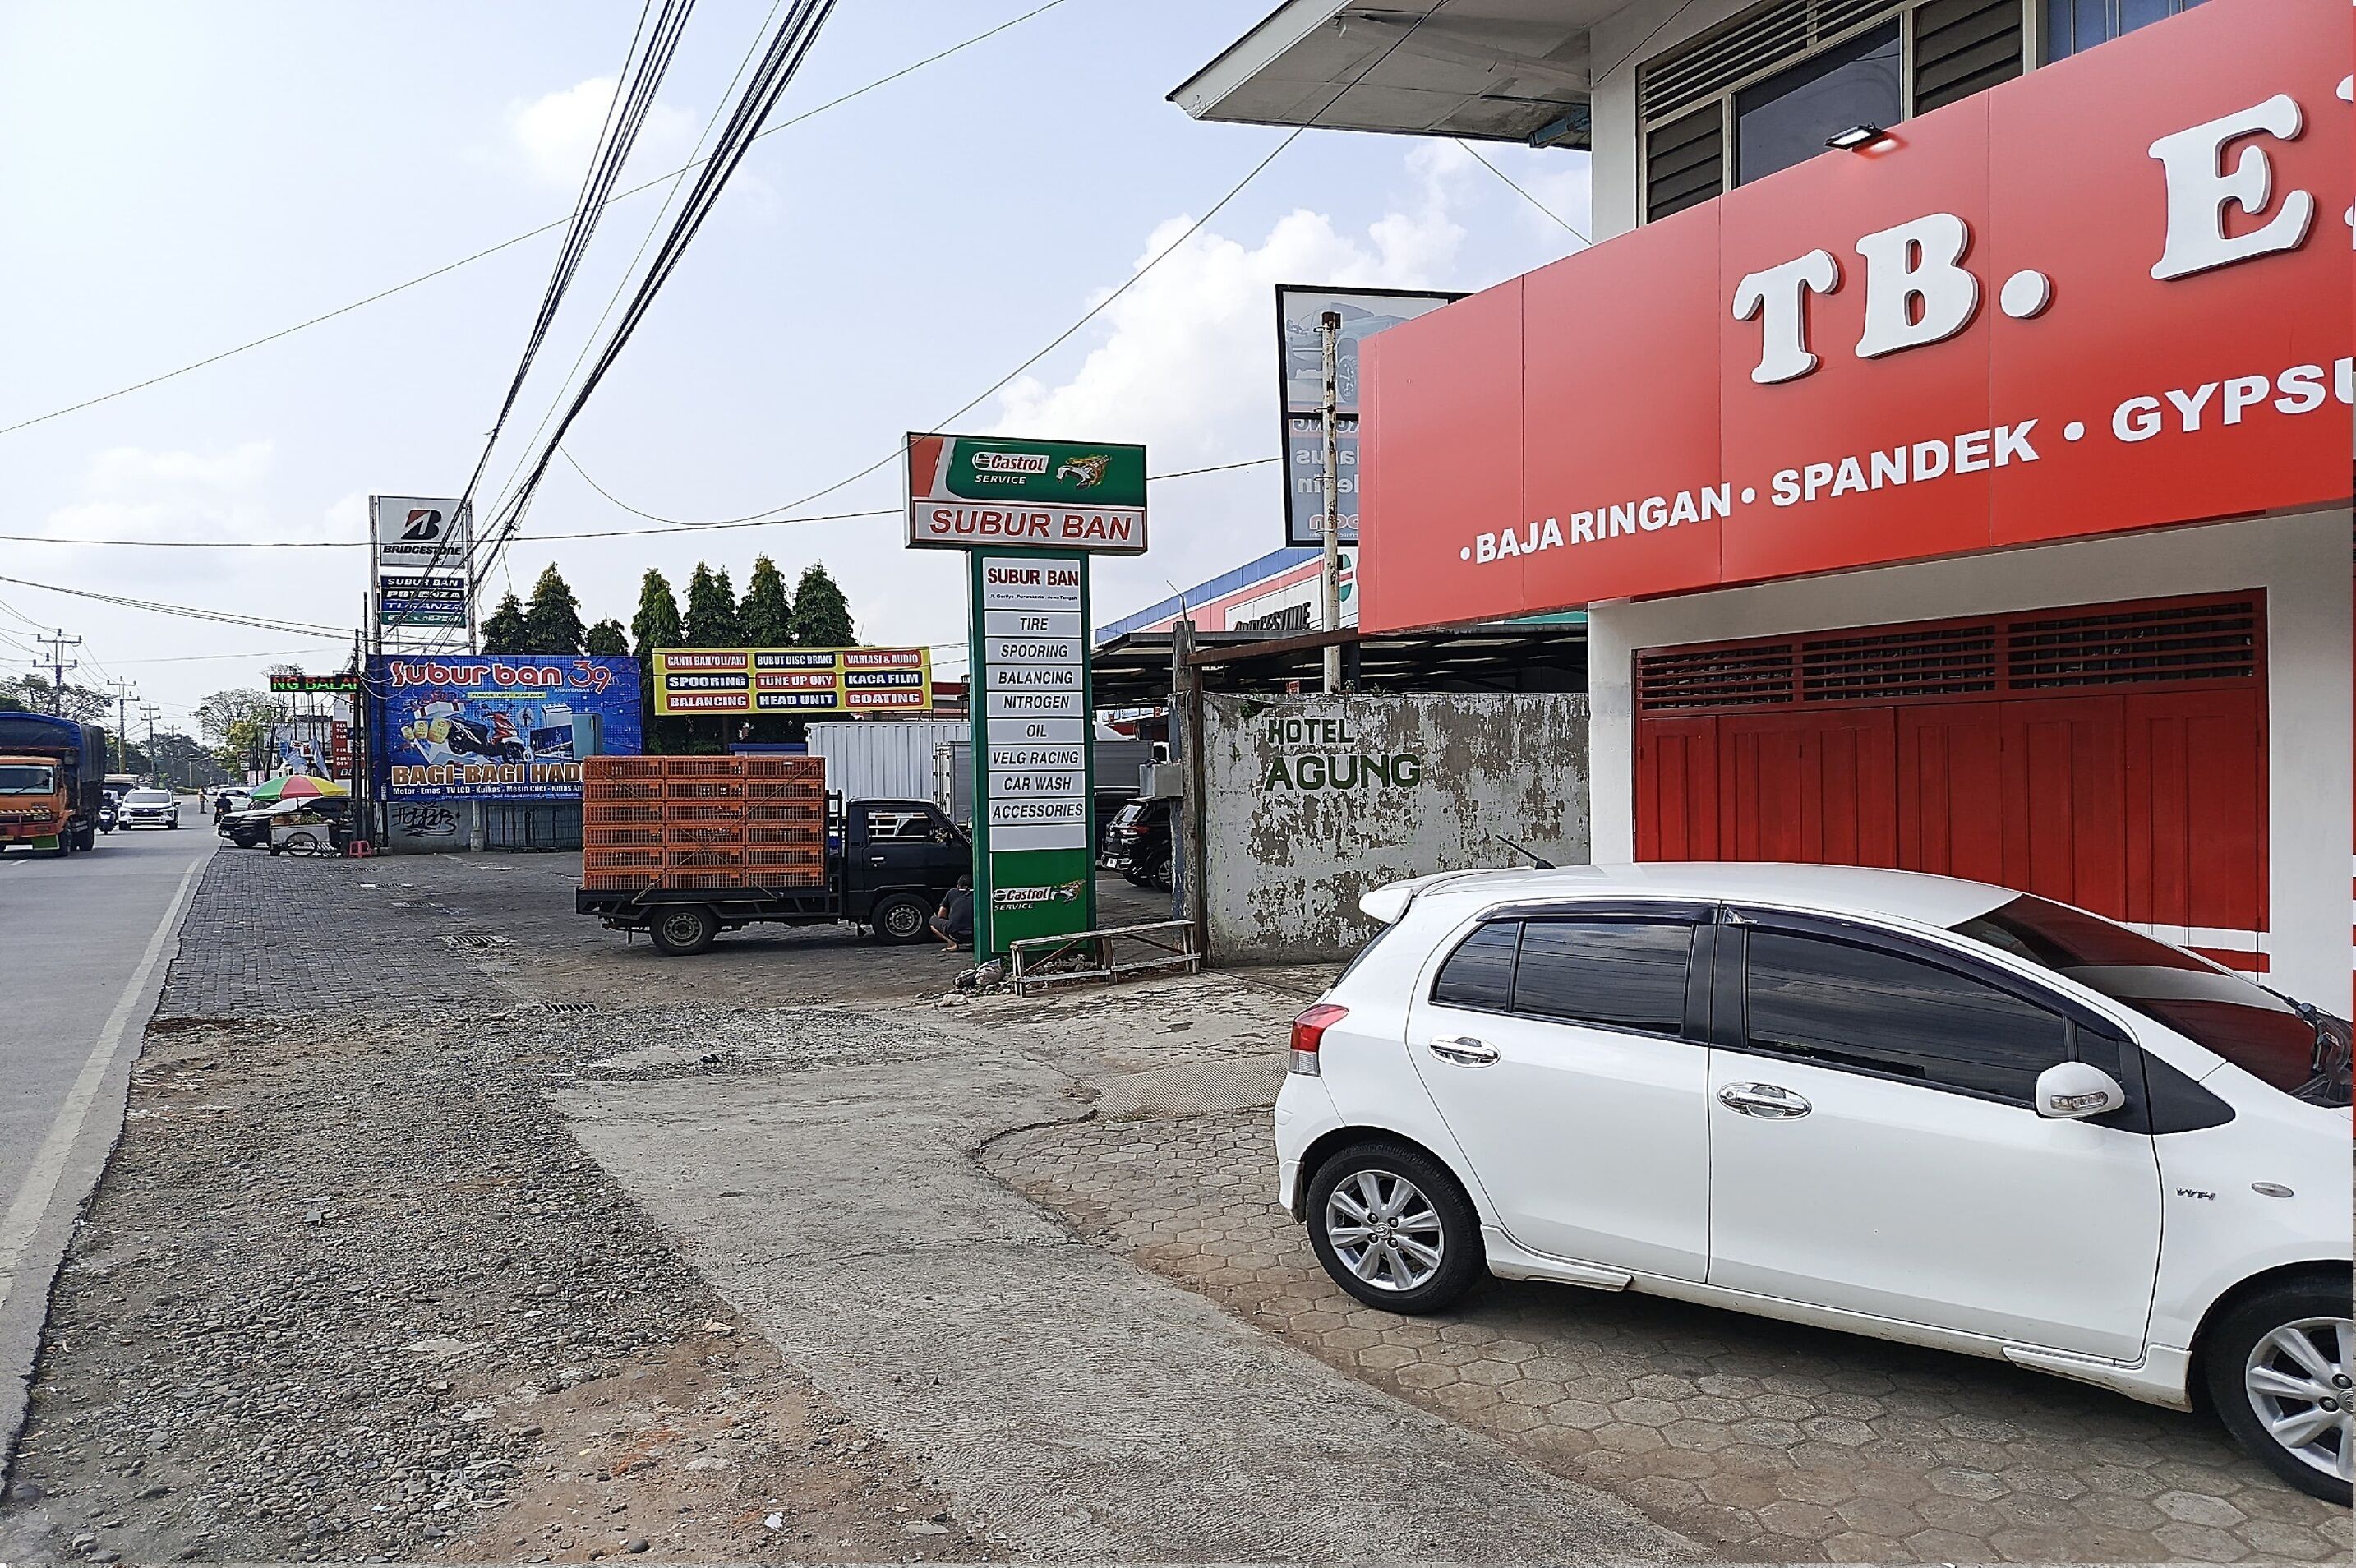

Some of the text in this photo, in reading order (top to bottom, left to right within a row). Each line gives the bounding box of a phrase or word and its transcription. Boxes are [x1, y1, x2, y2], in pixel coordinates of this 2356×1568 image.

[1732, 75, 2353, 384] TB. E
[991, 454, 1044, 471] Castrol
[975, 474, 1026, 485] SERVICE
[1476, 517, 1564, 564] BAJA
[1570, 482, 1731, 544] RINGAN
[1770, 419, 2040, 507] SPANDEK
[929, 509, 1132, 541] SUBUR BAN
[383, 545, 462, 555] BRIDGESTONE
[387, 578, 459, 587] SUBUR BAN
[987, 567, 1079, 586] SUBUR BAN
[1020, 617, 1049, 630] TIRE
[1001, 644, 1067, 658] SPOORING
[667, 656, 693, 666] GANTI
[757, 654, 833, 666] BUBUT DISC BRAKE
[846, 654, 919, 664] VARIASI & AUDIO
[390, 660, 612, 694] Subur ban 39
[668, 676, 746, 687] SPOORING
[758, 676, 789, 686] TUNE
[791, 676, 807, 685] UP
[848, 674, 919, 685] KACA FILM
[998, 671, 1073, 685] BALANCING
[670, 696, 747, 707] BALANCING
[759, 694, 833, 706] HEAD UNIT
[849, 693, 920, 704] COATING
[1003, 695, 1070, 708] NITROGEN
[1026, 724, 1047, 737] OIL
[1268, 718, 1355, 745] HOTEL
[993, 751, 1079, 764] VELG RACING
[391, 763, 584, 786] BAGI-BAGI HAD
[1264, 754, 1421, 791] AGUNG
[1003, 777, 1072, 791] CAR WASH
[992, 803, 1083, 819] ACCESSORIES
[1007, 888, 1048, 901] Castrol
[994, 903, 1034, 911] SERVICE
